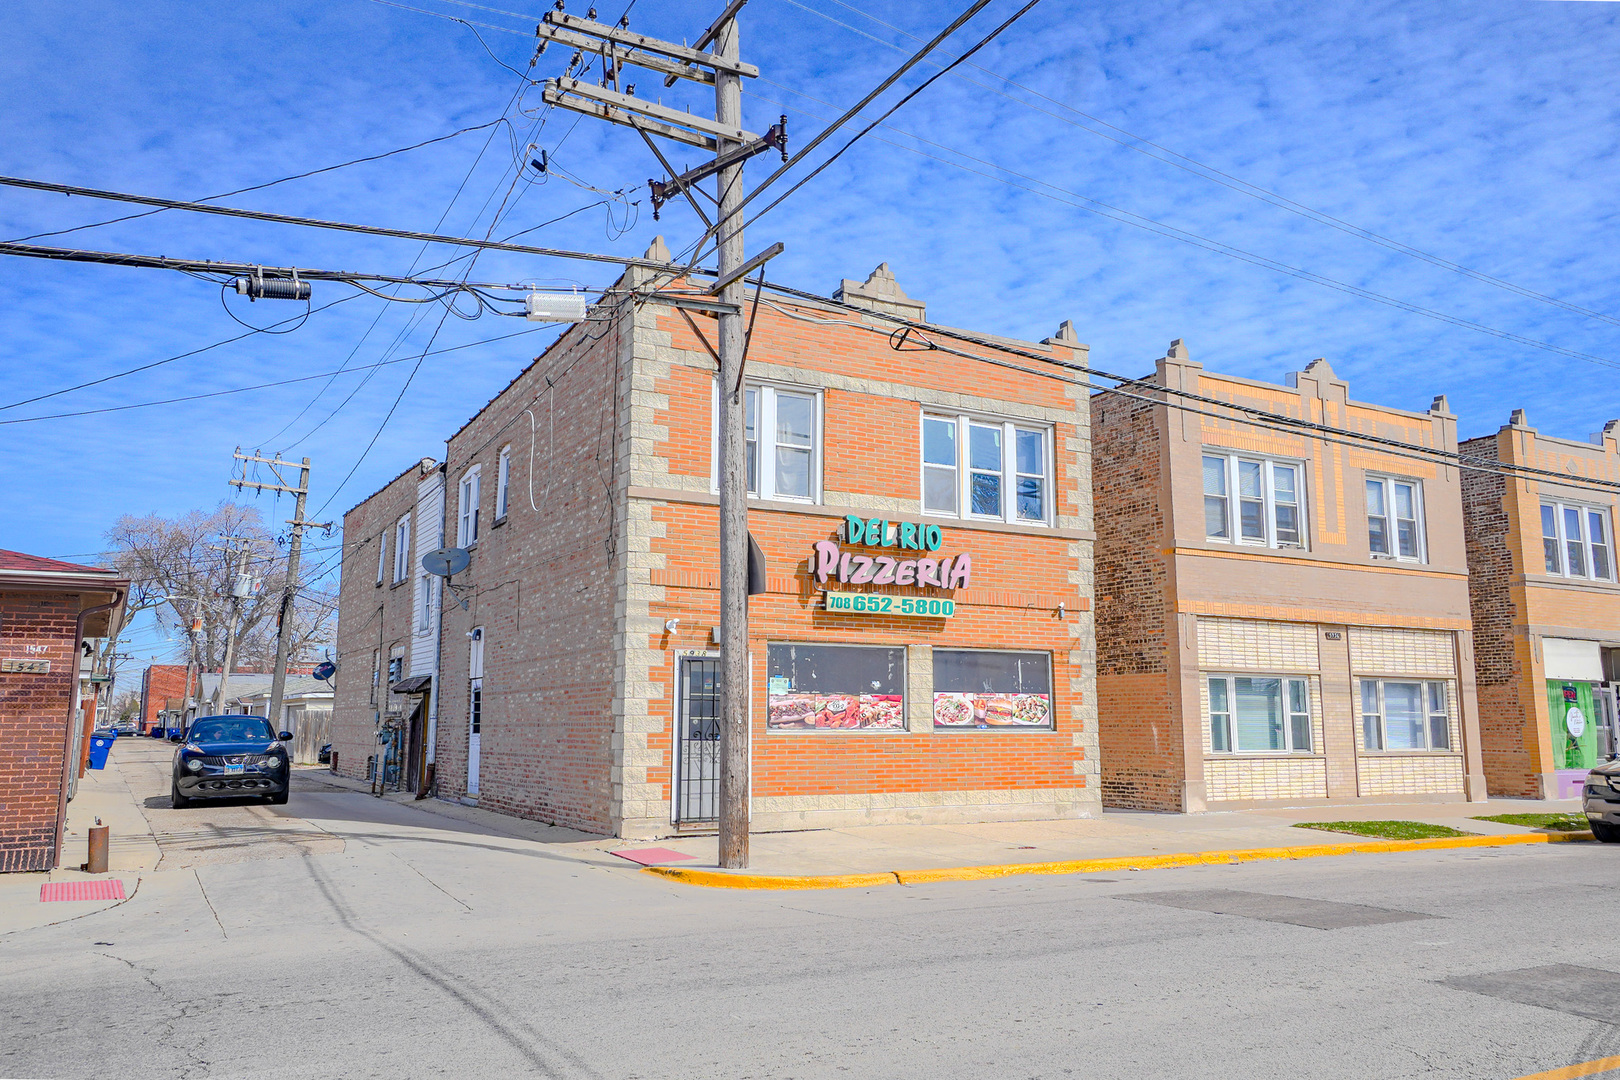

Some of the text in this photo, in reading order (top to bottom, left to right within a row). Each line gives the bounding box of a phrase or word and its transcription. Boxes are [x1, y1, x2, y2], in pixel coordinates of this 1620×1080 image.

[845, 514, 942, 551] DEL RIO
[813, 540, 971, 589] PIZZERIA
[829, 595, 954, 616] 708 652-5800
[26, 645, 48, 654] 1547
[1563, 690, 1577, 699] PEN
